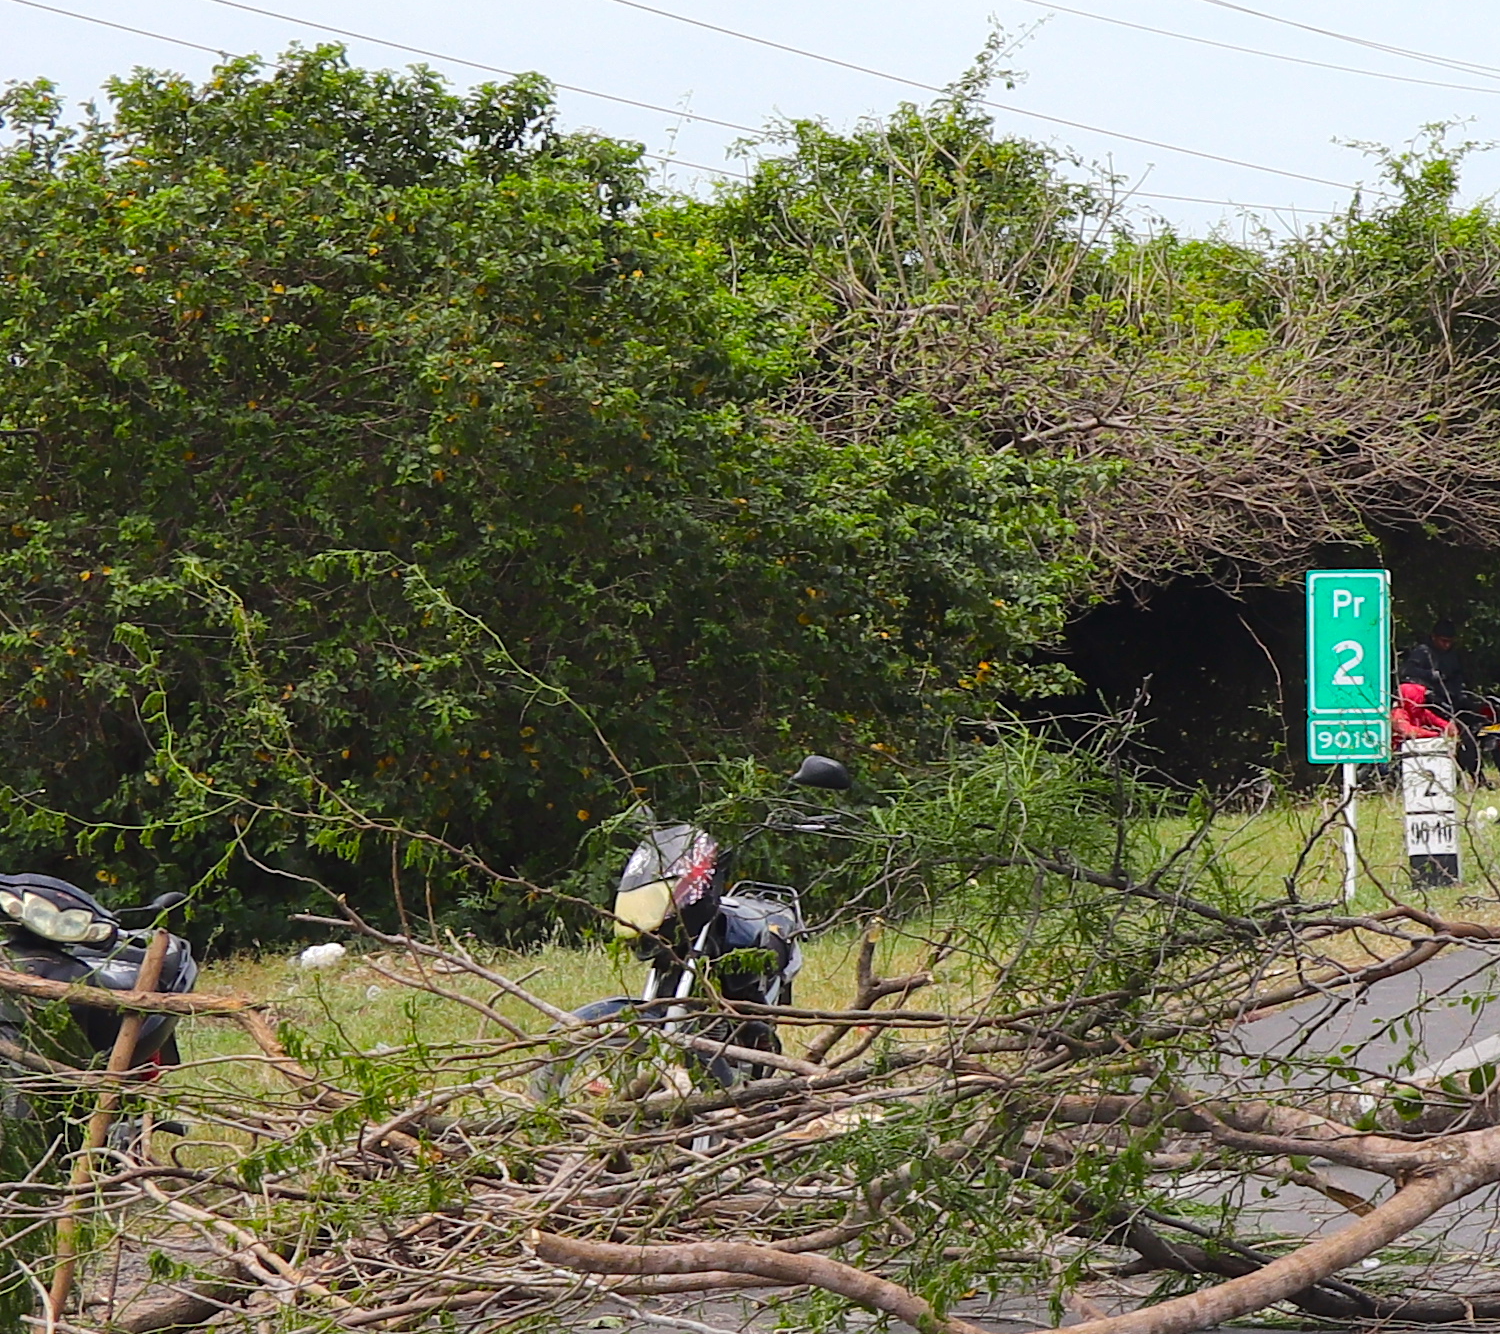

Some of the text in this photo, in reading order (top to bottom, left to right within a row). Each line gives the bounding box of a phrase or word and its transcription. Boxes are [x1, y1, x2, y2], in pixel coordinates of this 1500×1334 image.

[1332, 589, 1365, 618] Pr
[1332, 640, 1364, 685] 2
[1317, 731, 1378, 749] 9010
